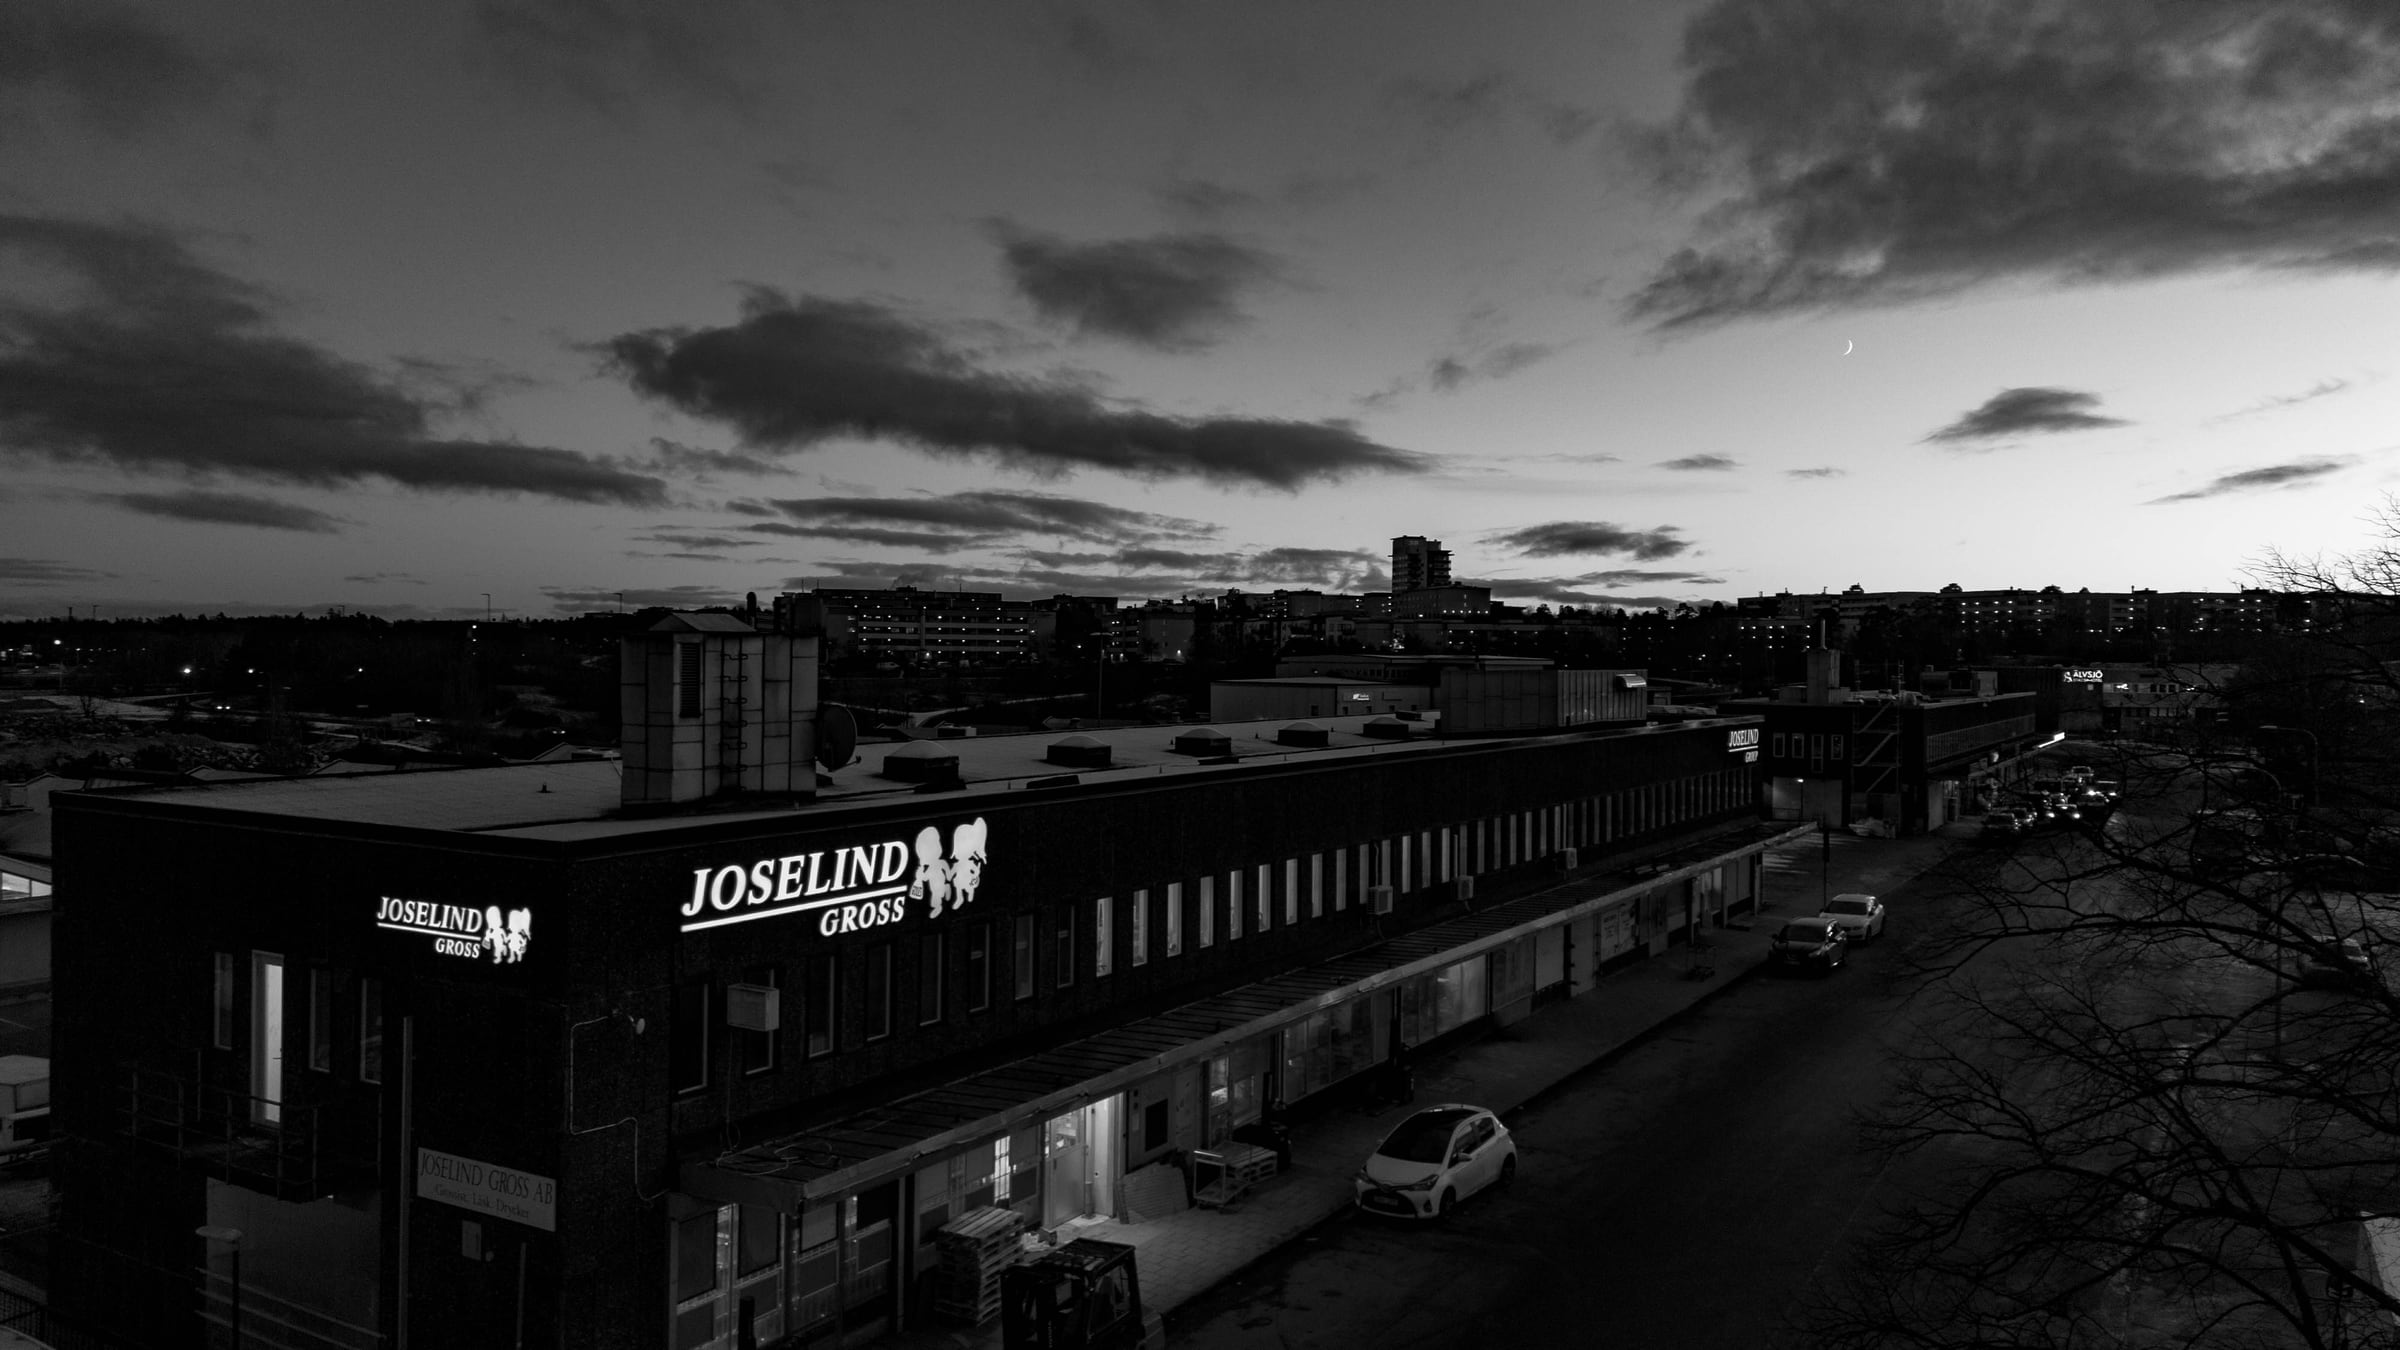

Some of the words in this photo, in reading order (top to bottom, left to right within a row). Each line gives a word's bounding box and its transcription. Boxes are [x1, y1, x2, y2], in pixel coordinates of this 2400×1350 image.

[2073, 669, 2103, 679] ÄLVSJÖ
[1729, 728, 1759, 747] JOSELIND
[681, 840, 909, 917] JOSELIND
[377, 896, 483, 933] JOSELIND
[819, 895, 906, 937] GROSS
[435, 937, 481, 959] GROSS
[420, 1152, 483, 1187] JOSELIND
[488, 1169, 529, 1199] GROSS
[533, 1181, 553, 1205] AB
